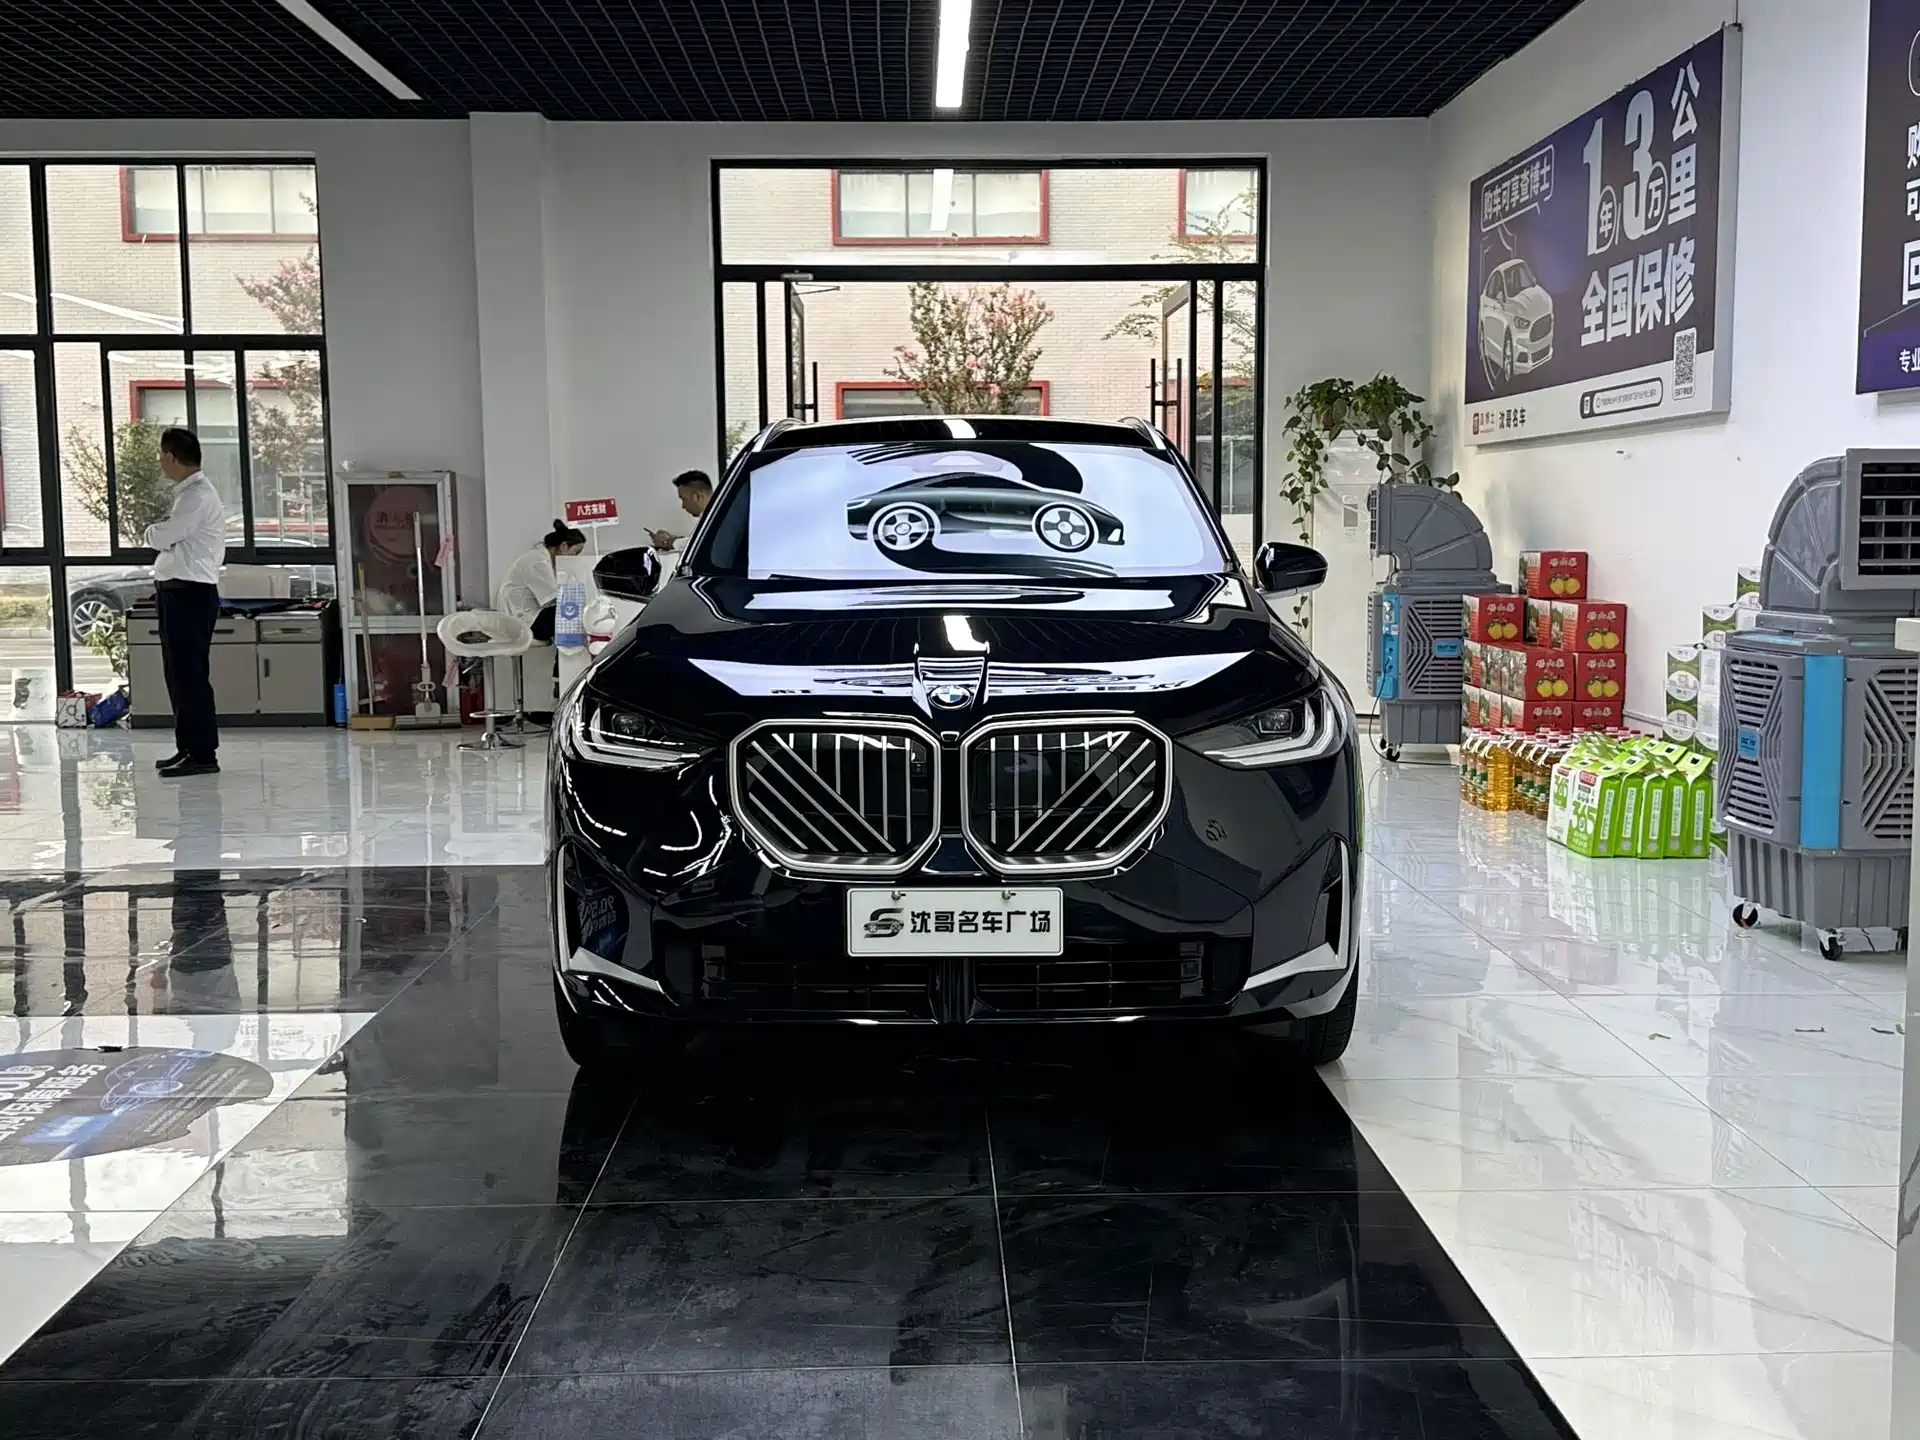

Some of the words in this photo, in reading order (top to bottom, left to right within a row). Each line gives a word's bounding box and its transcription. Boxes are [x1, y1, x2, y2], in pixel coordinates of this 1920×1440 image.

[1483, 156, 1550, 221] 购车可享查博士
[1581, 236, 1695, 347] 全国保修
[910, 910, 1051, 933] 沈哥名车广场
